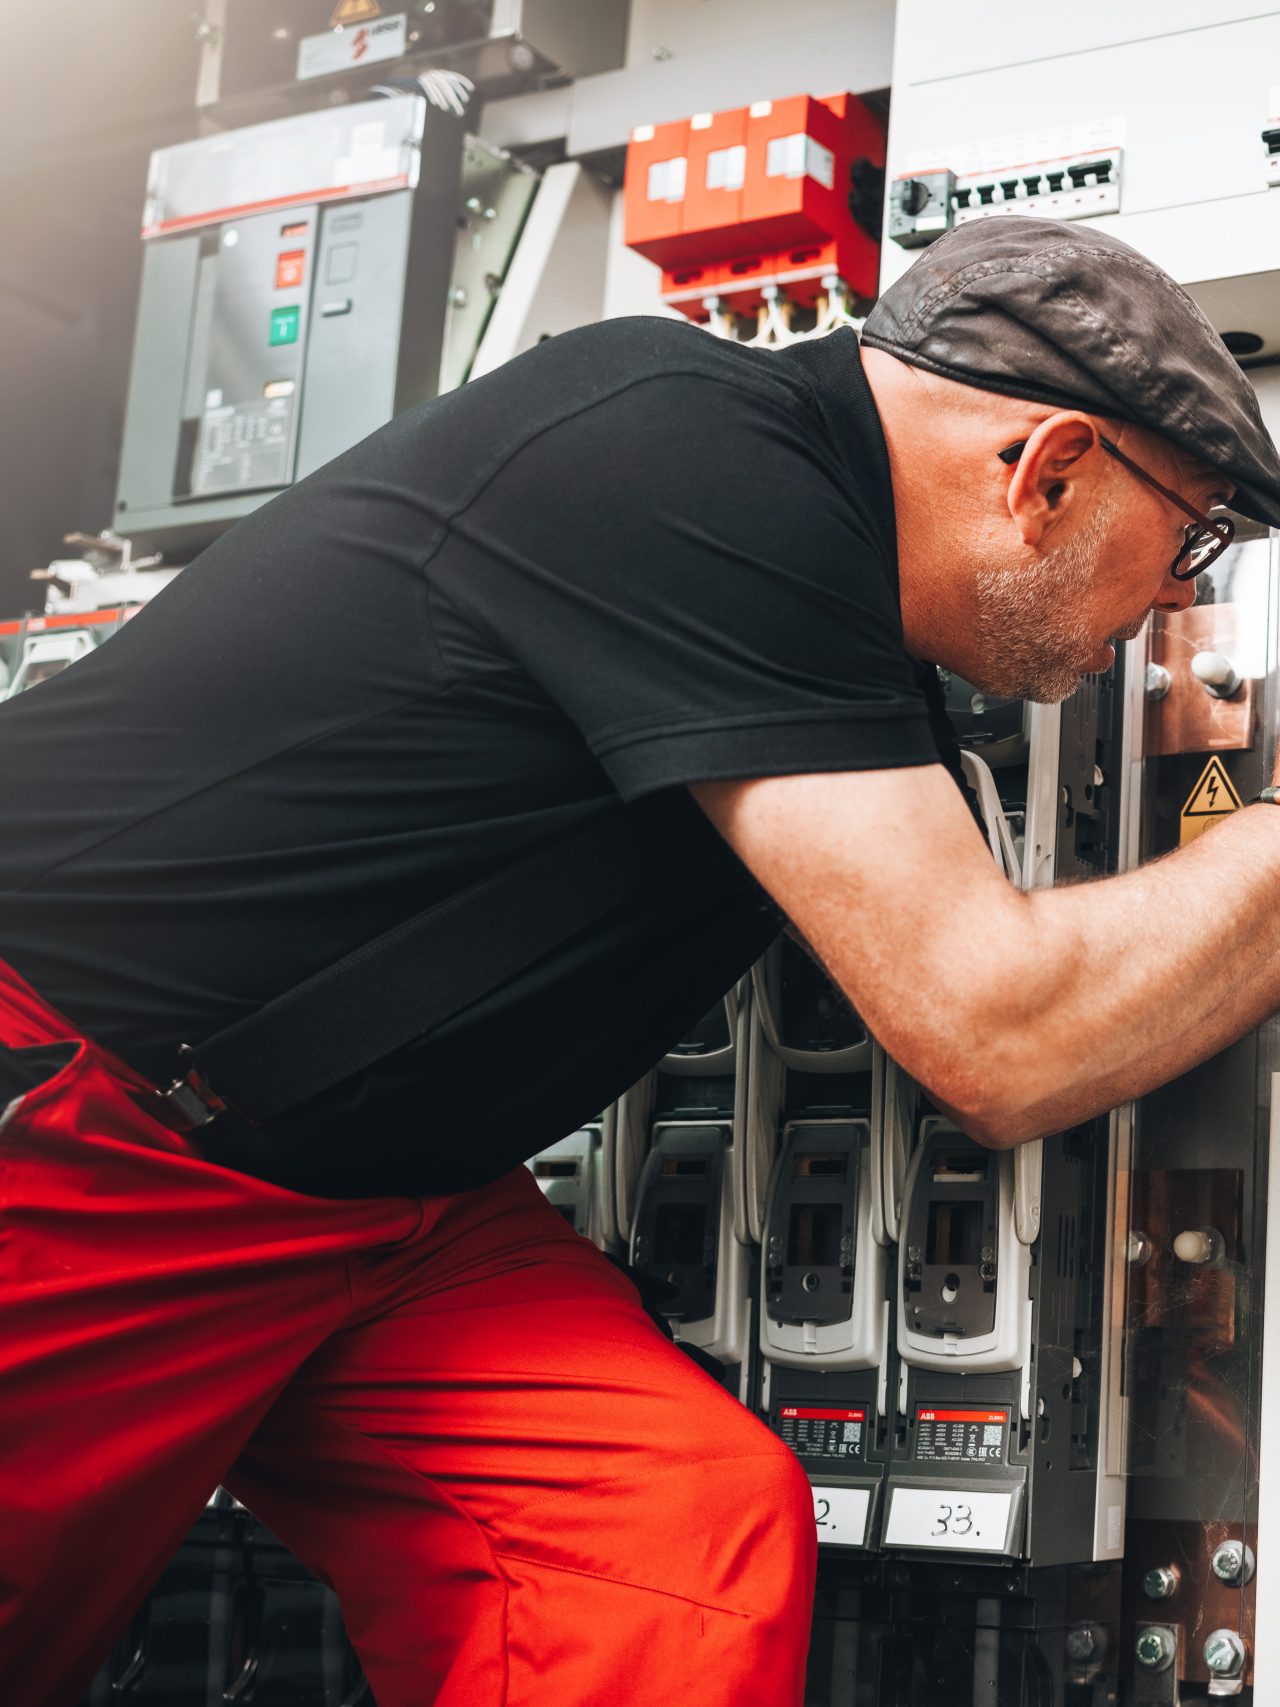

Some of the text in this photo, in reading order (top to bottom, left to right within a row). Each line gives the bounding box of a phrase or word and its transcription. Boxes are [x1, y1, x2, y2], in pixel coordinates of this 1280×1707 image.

[783, 1408, 798, 1416] ABB
[920, 1412, 935, 1420] ABB
[930, 1504, 981, 1537] 33.
